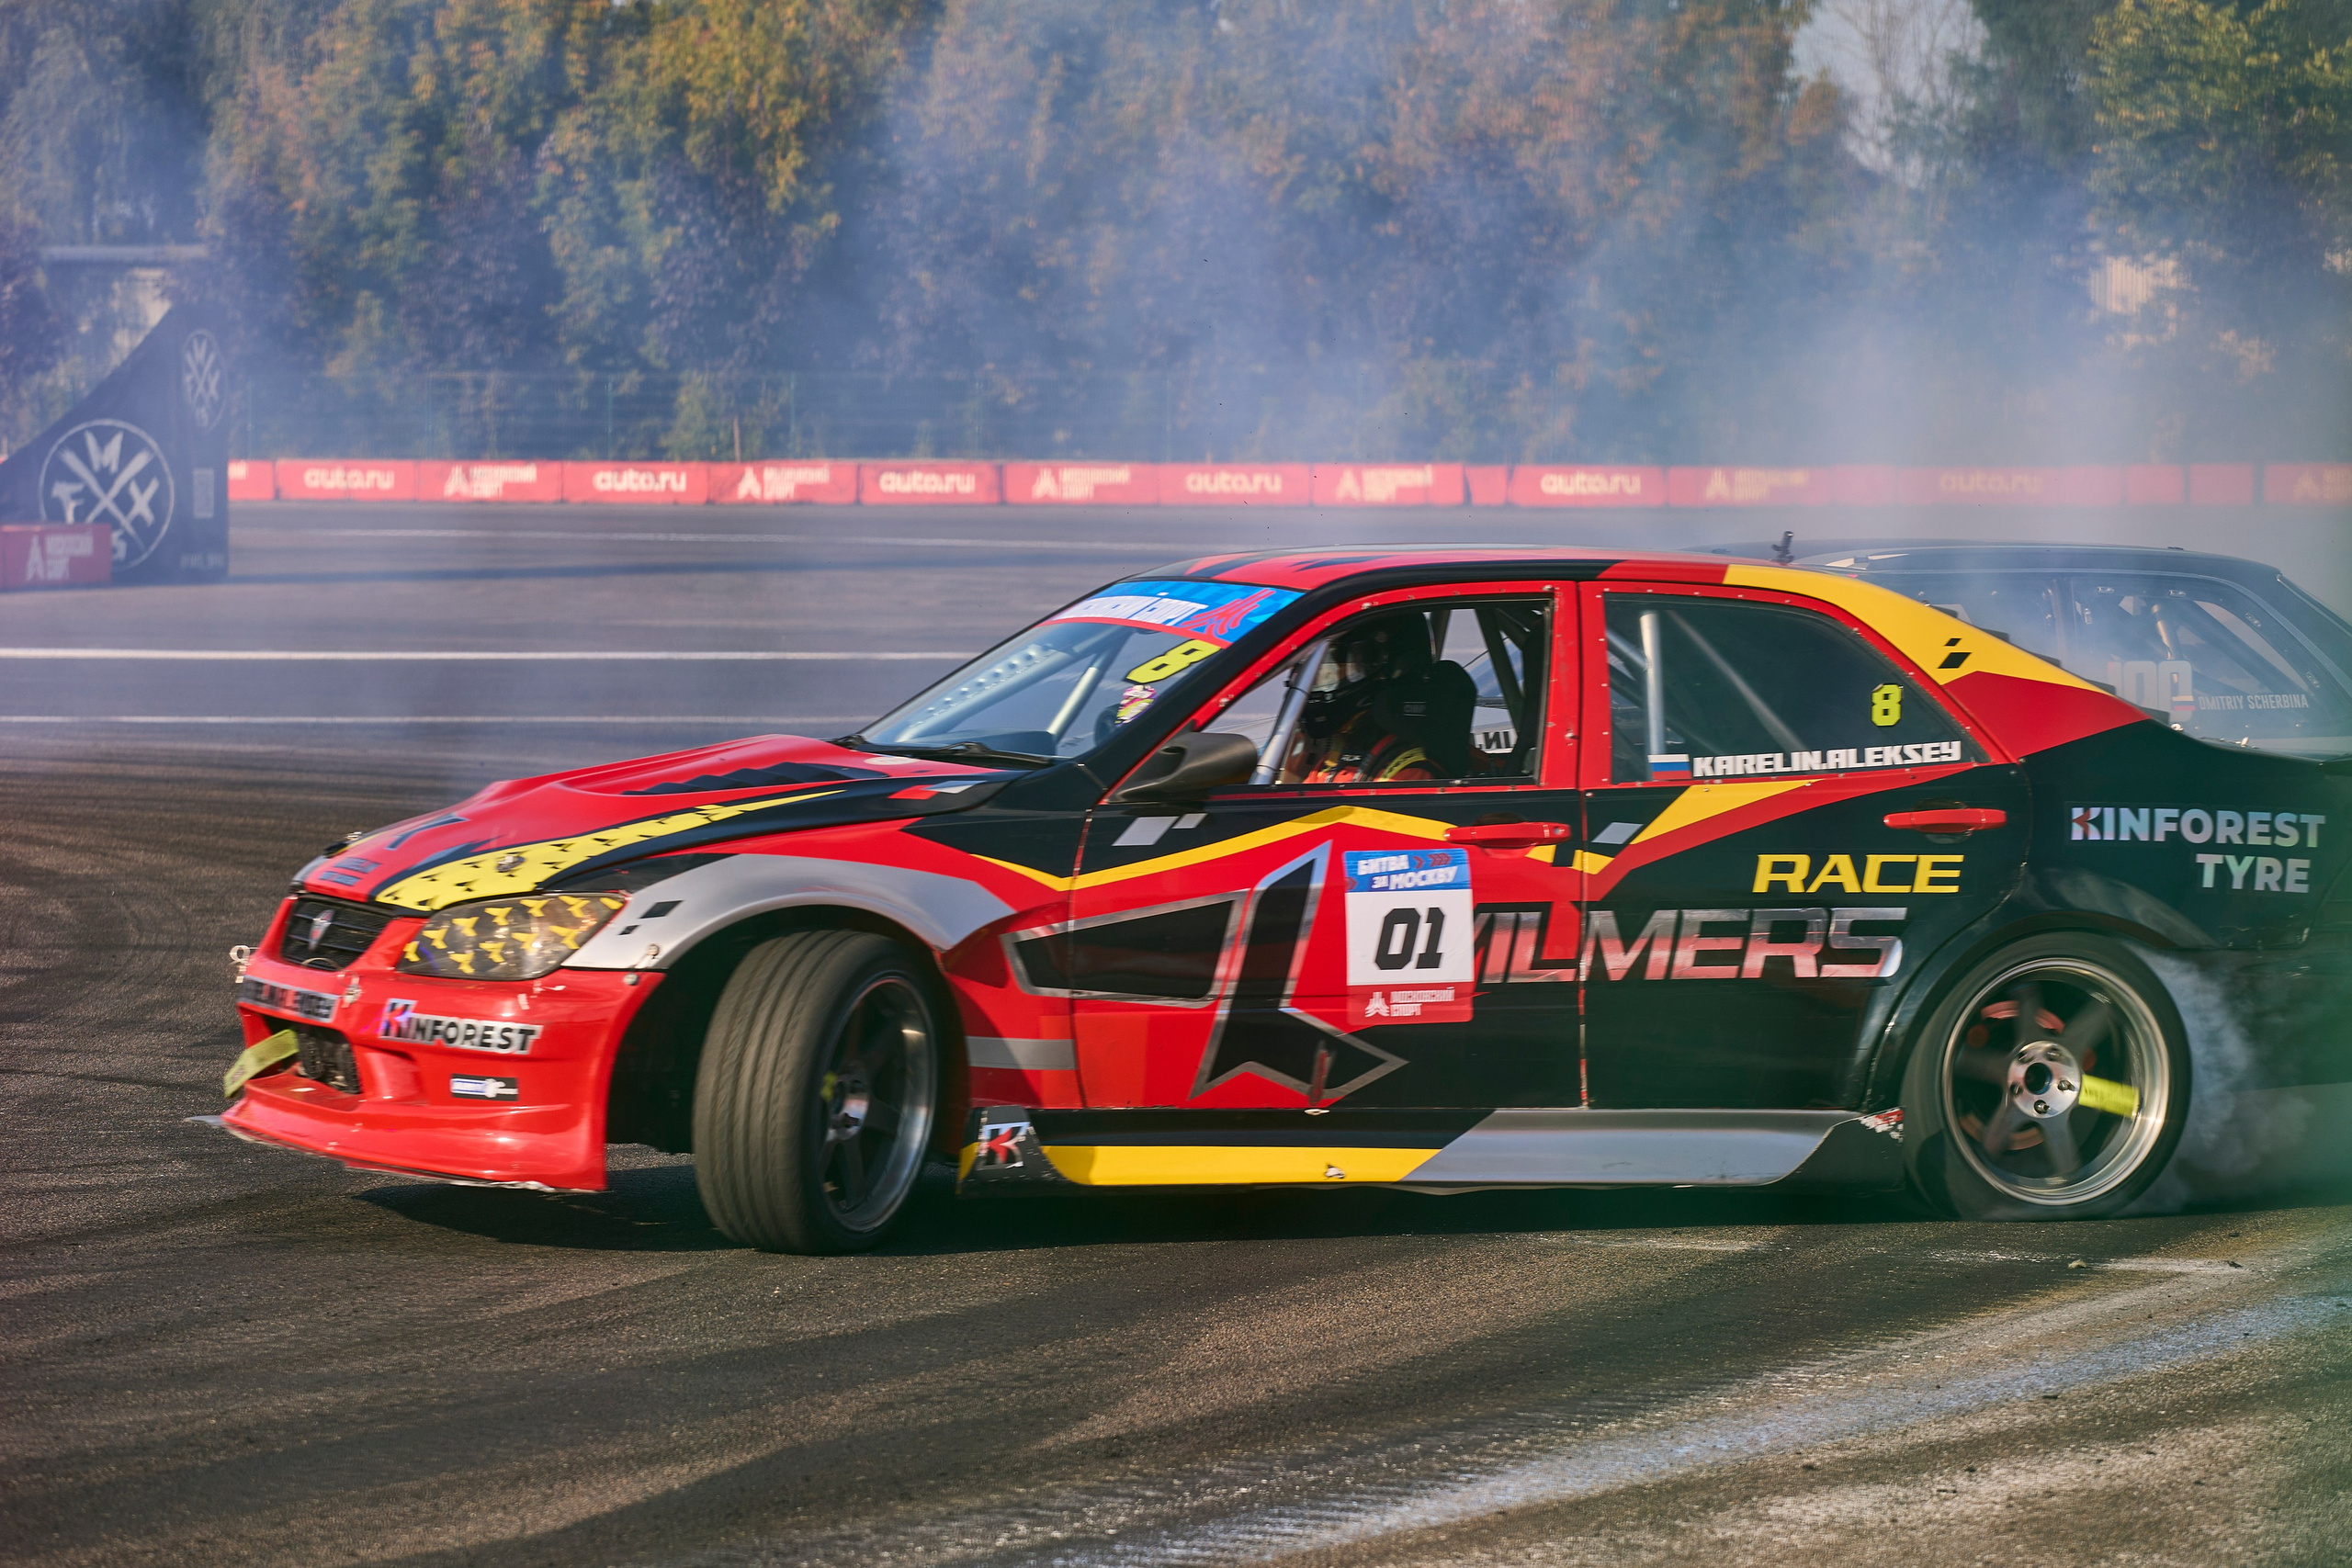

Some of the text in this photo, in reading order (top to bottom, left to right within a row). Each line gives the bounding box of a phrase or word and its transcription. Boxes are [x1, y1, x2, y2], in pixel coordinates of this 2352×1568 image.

[592, 468, 687, 492] auto.ru
[879, 469, 976, 493] auto.ru
[1125, 638, 1222, 684] 8
[1871, 683, 1902, 727] 8
[2199, 694, 2309, 711] DMITRIY SCHERBINA
[2071, 807, 2325, 848] KINFOREST
[1752, 854, 1964, 893] RACE
[2196, 853, 2311, 893] TYRE
[1374, 907, 1446, 970] 01
[1472, 908, 1908, 984] ILMERS
[382, 1001, 537, 1052] KINFOREST
